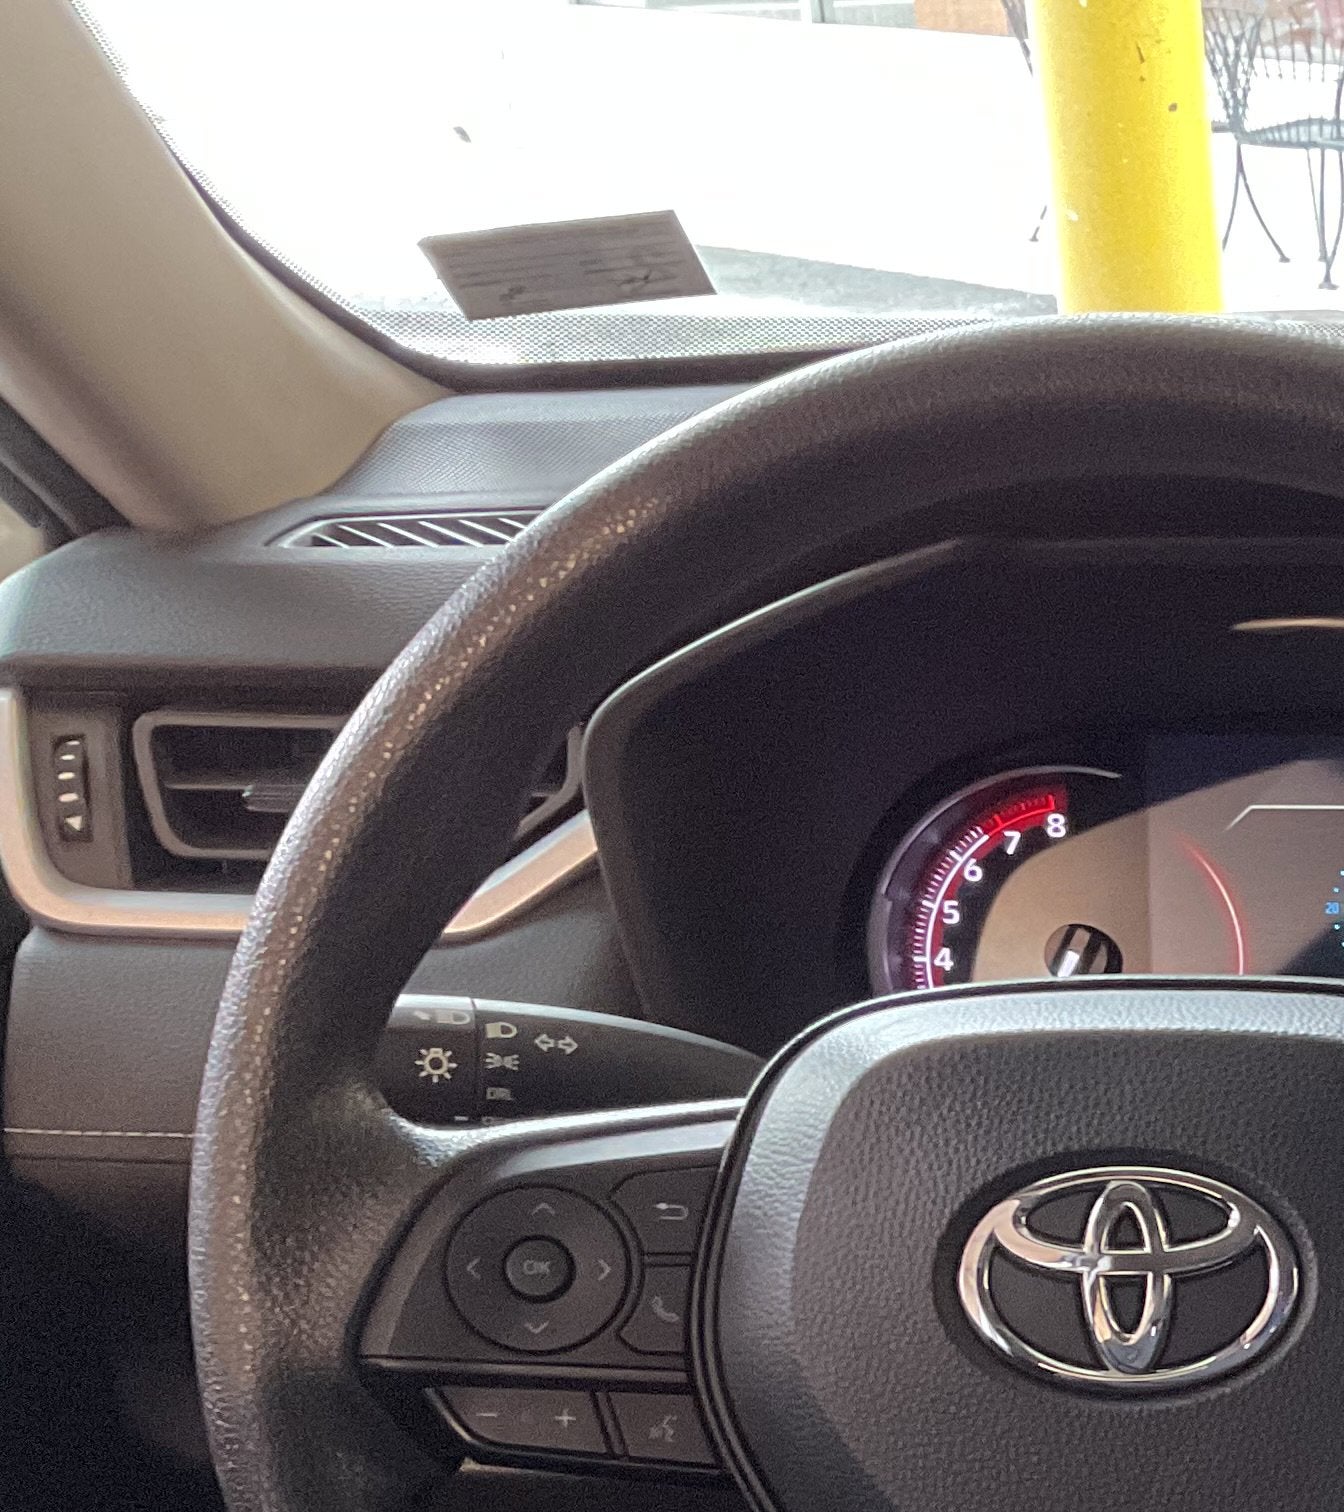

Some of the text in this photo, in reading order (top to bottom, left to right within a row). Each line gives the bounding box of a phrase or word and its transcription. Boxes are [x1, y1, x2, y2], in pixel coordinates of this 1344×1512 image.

[1046, 813, 1067, 838] 8
[1003, 830, 1022, 855] 7
[963, 858, 983, 882] 6
[942, 900, 960, 924] 5
[933, 946, 954, 971] 4
[522, 1259, 552, 1277] OK
